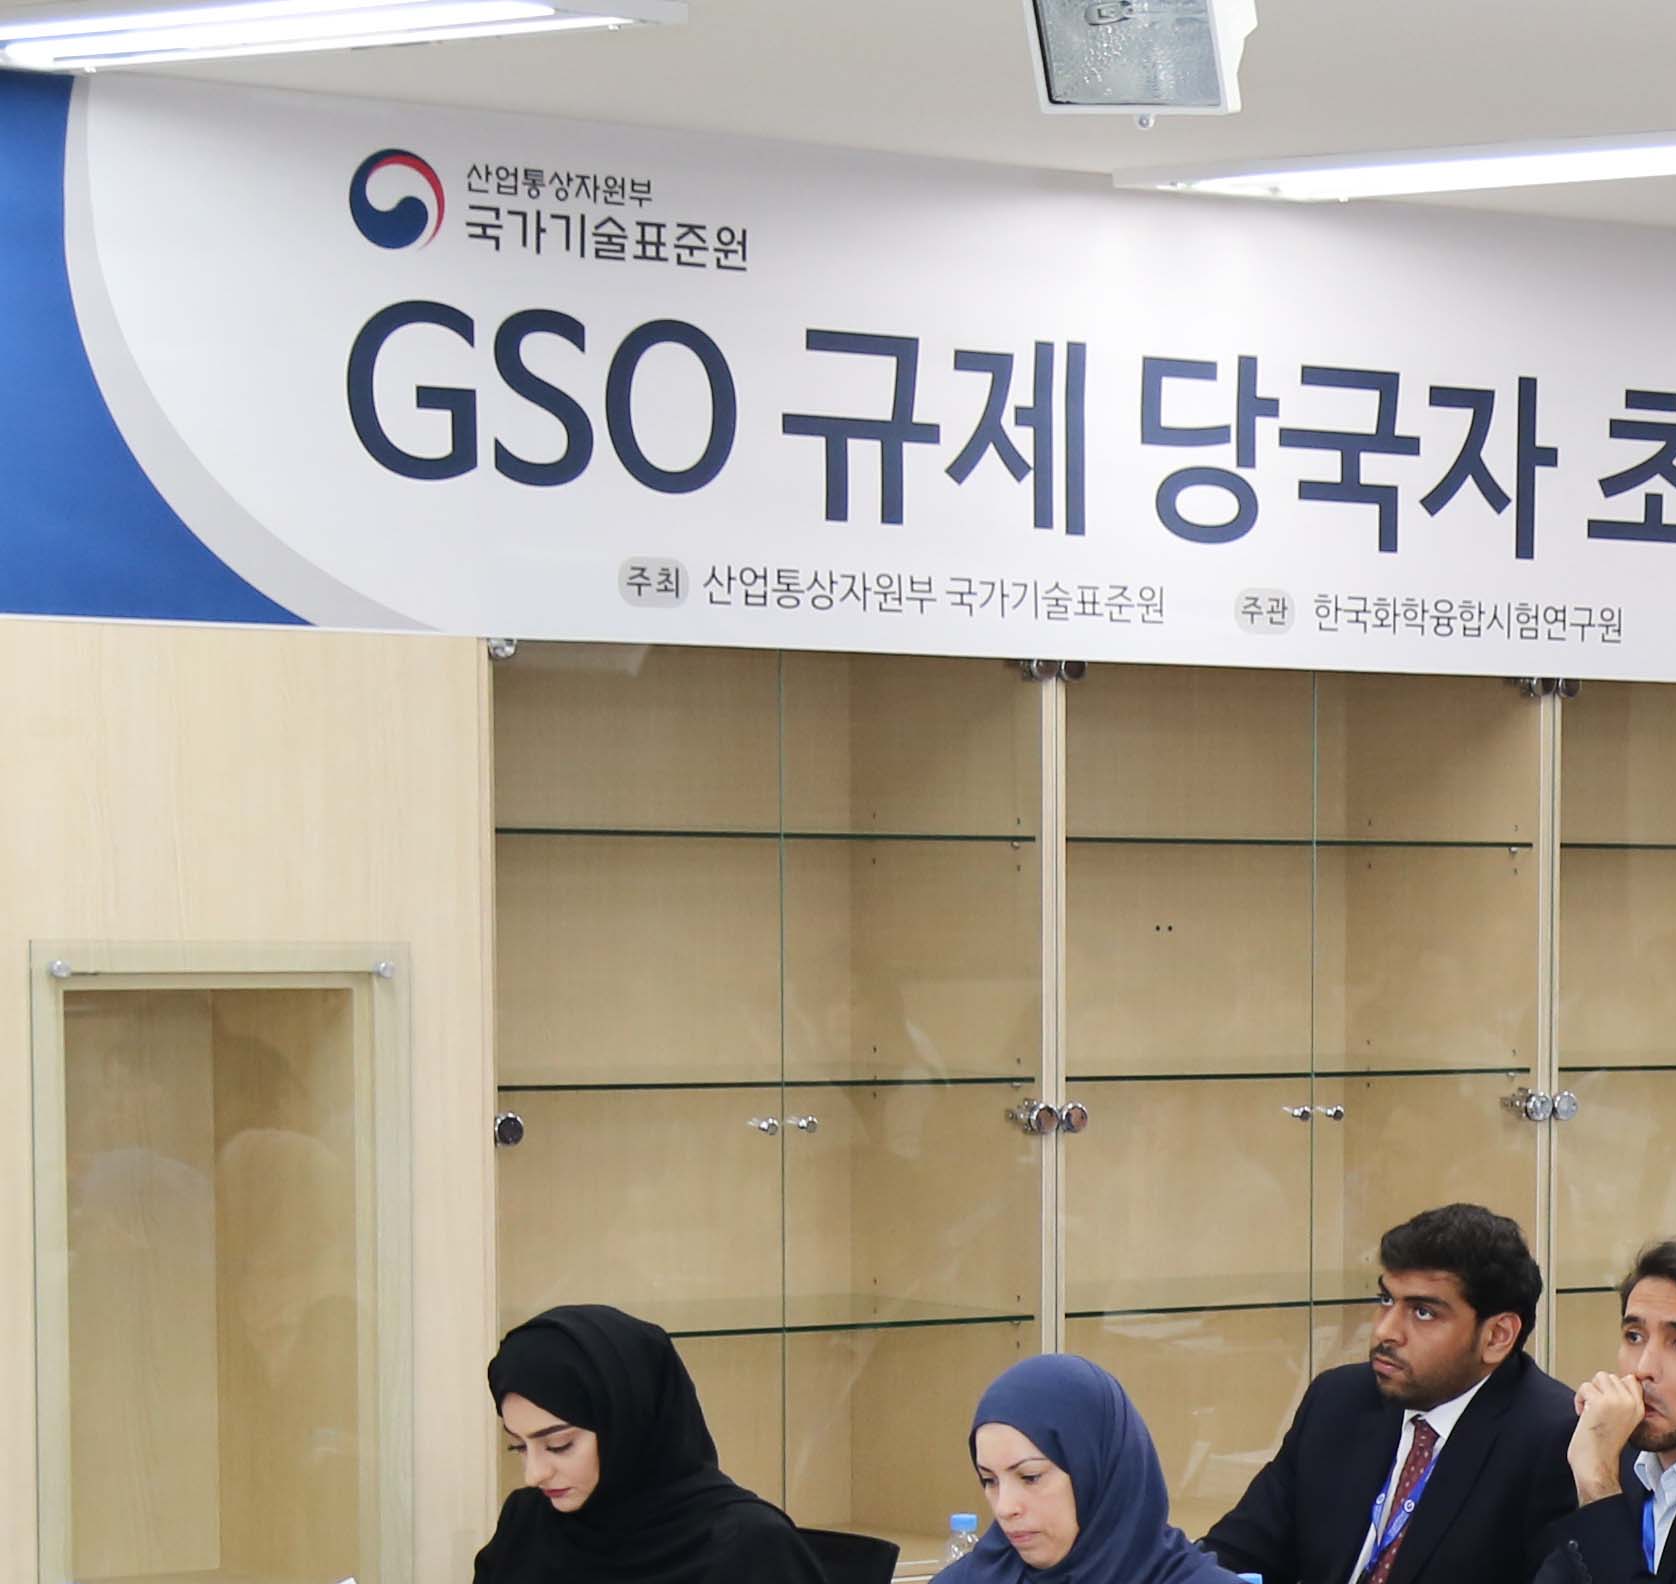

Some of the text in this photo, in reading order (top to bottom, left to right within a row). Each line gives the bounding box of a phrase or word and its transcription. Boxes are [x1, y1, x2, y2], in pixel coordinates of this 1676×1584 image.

[466, 162, 653, 207] 산업통상자원부
[464, 206, 749, 271] 국가기술표준원
[346, 300, 738, 494] GSO
[781, 328, 1087, 536] 규제
[1140, 354, 1559, 560] 당국자
[625, 565, 1165, 624] 주최 산업통상자원부 국가기술표준원
[1239, 594, 1622, 645] 주관 한국화학융합시험연구원
